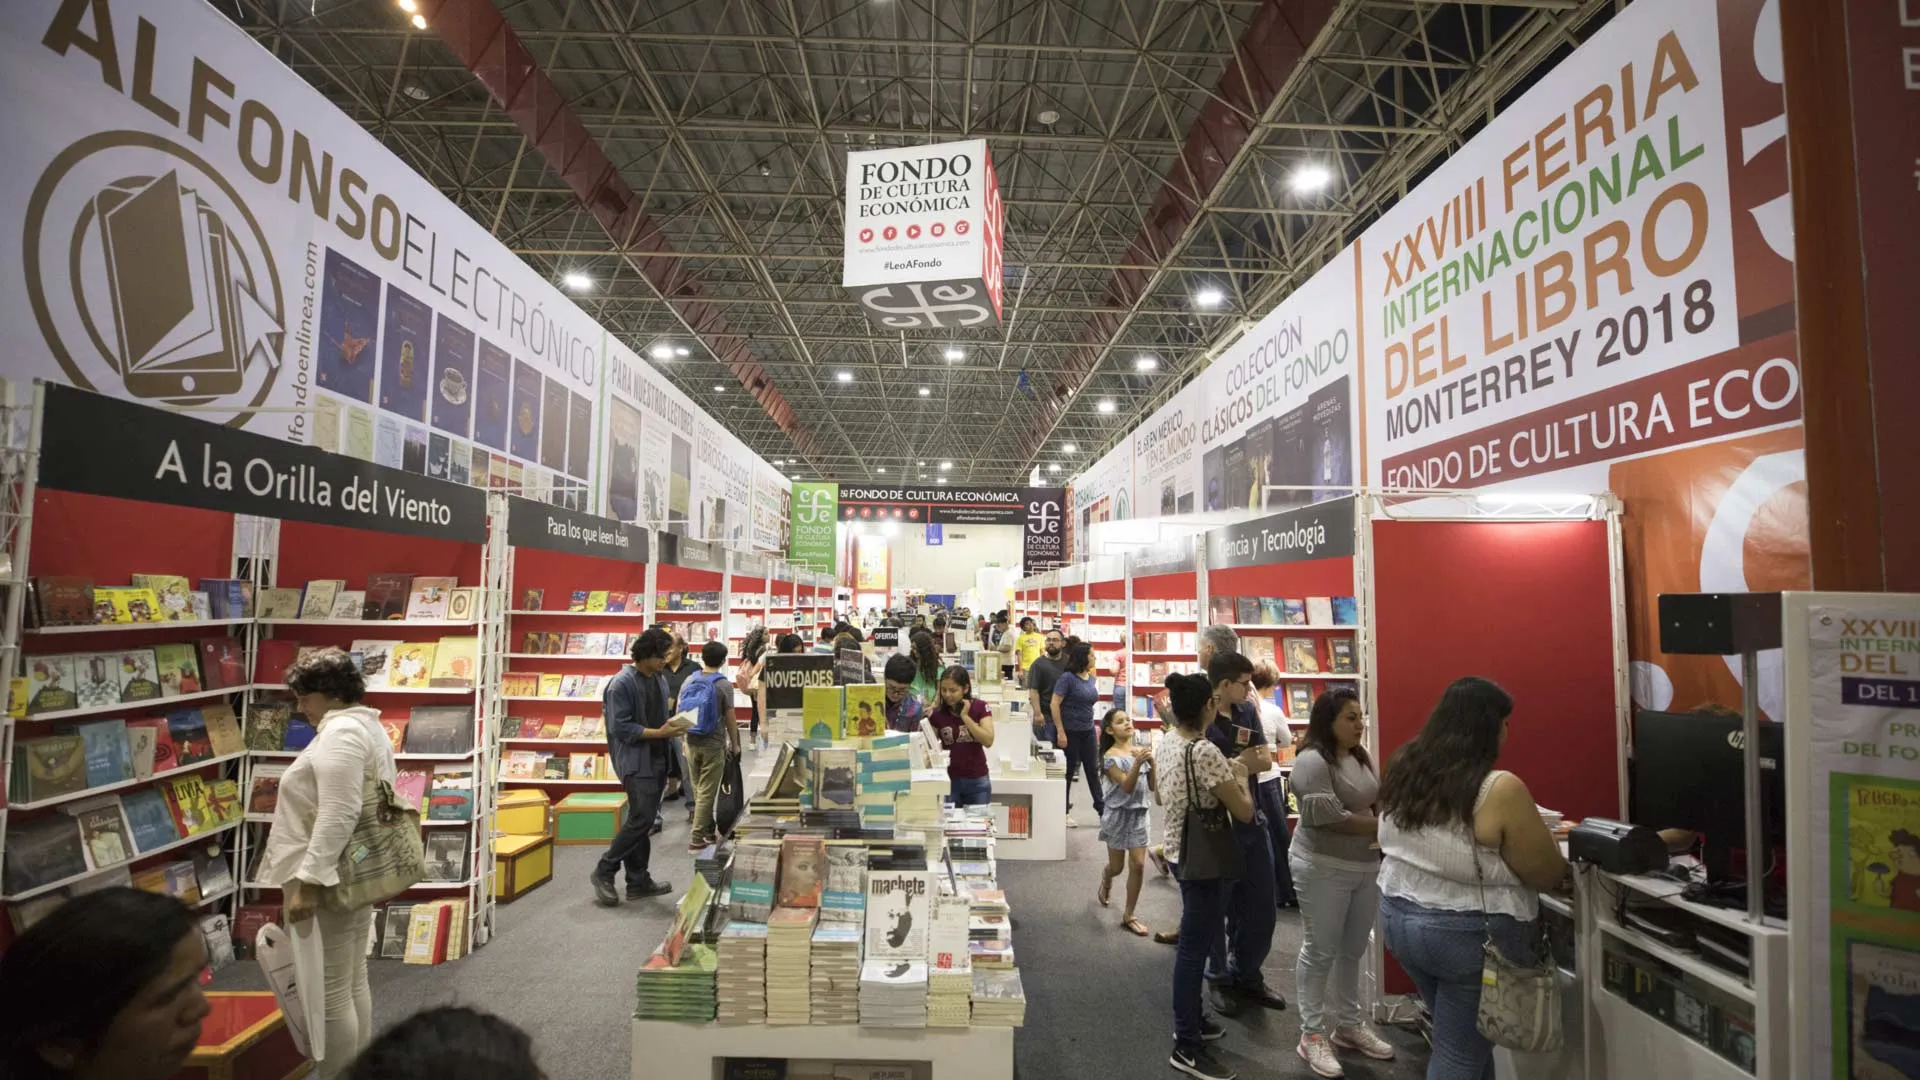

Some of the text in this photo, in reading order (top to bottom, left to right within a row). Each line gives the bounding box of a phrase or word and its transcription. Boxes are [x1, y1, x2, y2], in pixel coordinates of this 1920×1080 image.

[861, 154, 972, 186] FONDO
[1382, 177, 1487, 297] XXVIII
[1502, 30, 1700, 213] FERIA
[860, 178, 971, 201] DE CULTURA
[859, 195, 971, 218] ECONÓMICA
[1383, 114, 1705, 339] INTERNACIONAL
[884, 258, 942, 271] #LeoAFondo
[1384, 181, 1709, 400] DEL LIBRO
[1226, 315, 1302, 396] COLECCIÓN
[1386, 279, 1715, 442] MONTERREY 2018
[612, 356, 632, 397] PARA
[633, 369, 667, 420] NUESTROS
[1202, 328, 1348, 445] CLÁSICOS DEL FONDO
[1150, 428, 1157, 447] EN
[1158, 409, 1183, 440] MÉXICO
[1167, 421, 1196, 456] MUNDO
[1387, 358, 1799, 493] FONDO DE CULTURA ECO
[154, 439, 451, 527] A la Orilla del Viento
[849, 489, 1019, 502] FONDO DE CULTURA ECONÓMICA
[547, 516, 629, 548] Para los que leen bien
[796, 526, 831, 534] FONDO
[1028, 536, 1060, 544] FONDO
[1251, 536, 1259, 560] y
[1262, 519, 1326, 554] Tecnología
[874, 632, 899, 640] OFERTAS
[1841, 619, 1920, 638] XXVII
[766, 669, 834, 688] NOVEDADES
[1840, 653, 1908, 674] DEL
[1859, 684, 1899, 700] DEL
[1843, 741, 1882, 758] DEL
[872, 875, 925, 895] machete
